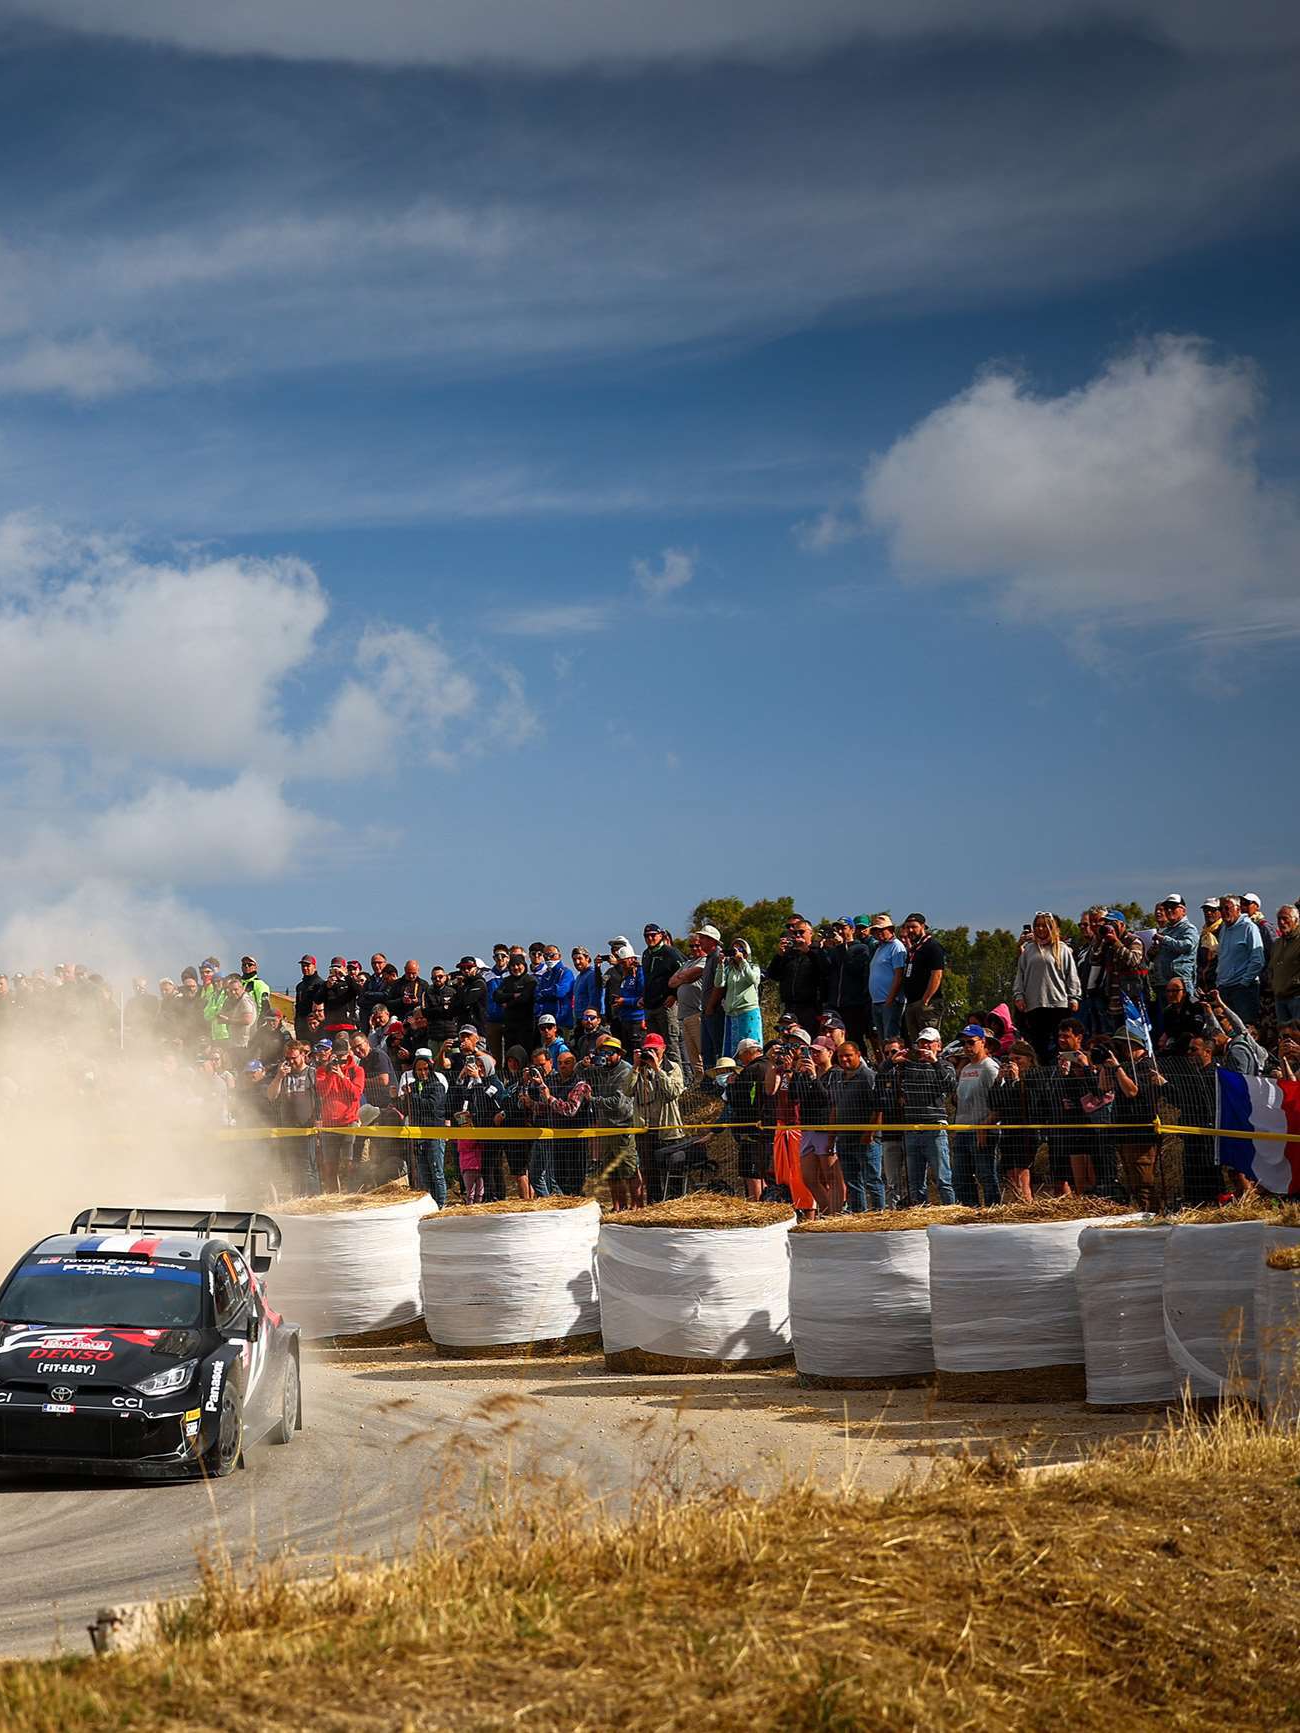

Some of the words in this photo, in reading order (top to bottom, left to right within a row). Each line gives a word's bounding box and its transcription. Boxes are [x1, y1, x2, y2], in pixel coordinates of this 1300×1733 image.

[149, 1261, 187, 1270] Racing
[27, 1348, 115, 1361] DENSO
[204, 1360, 225, 1412] Panasonic
[111, 1396, 144, 1409] CCI
